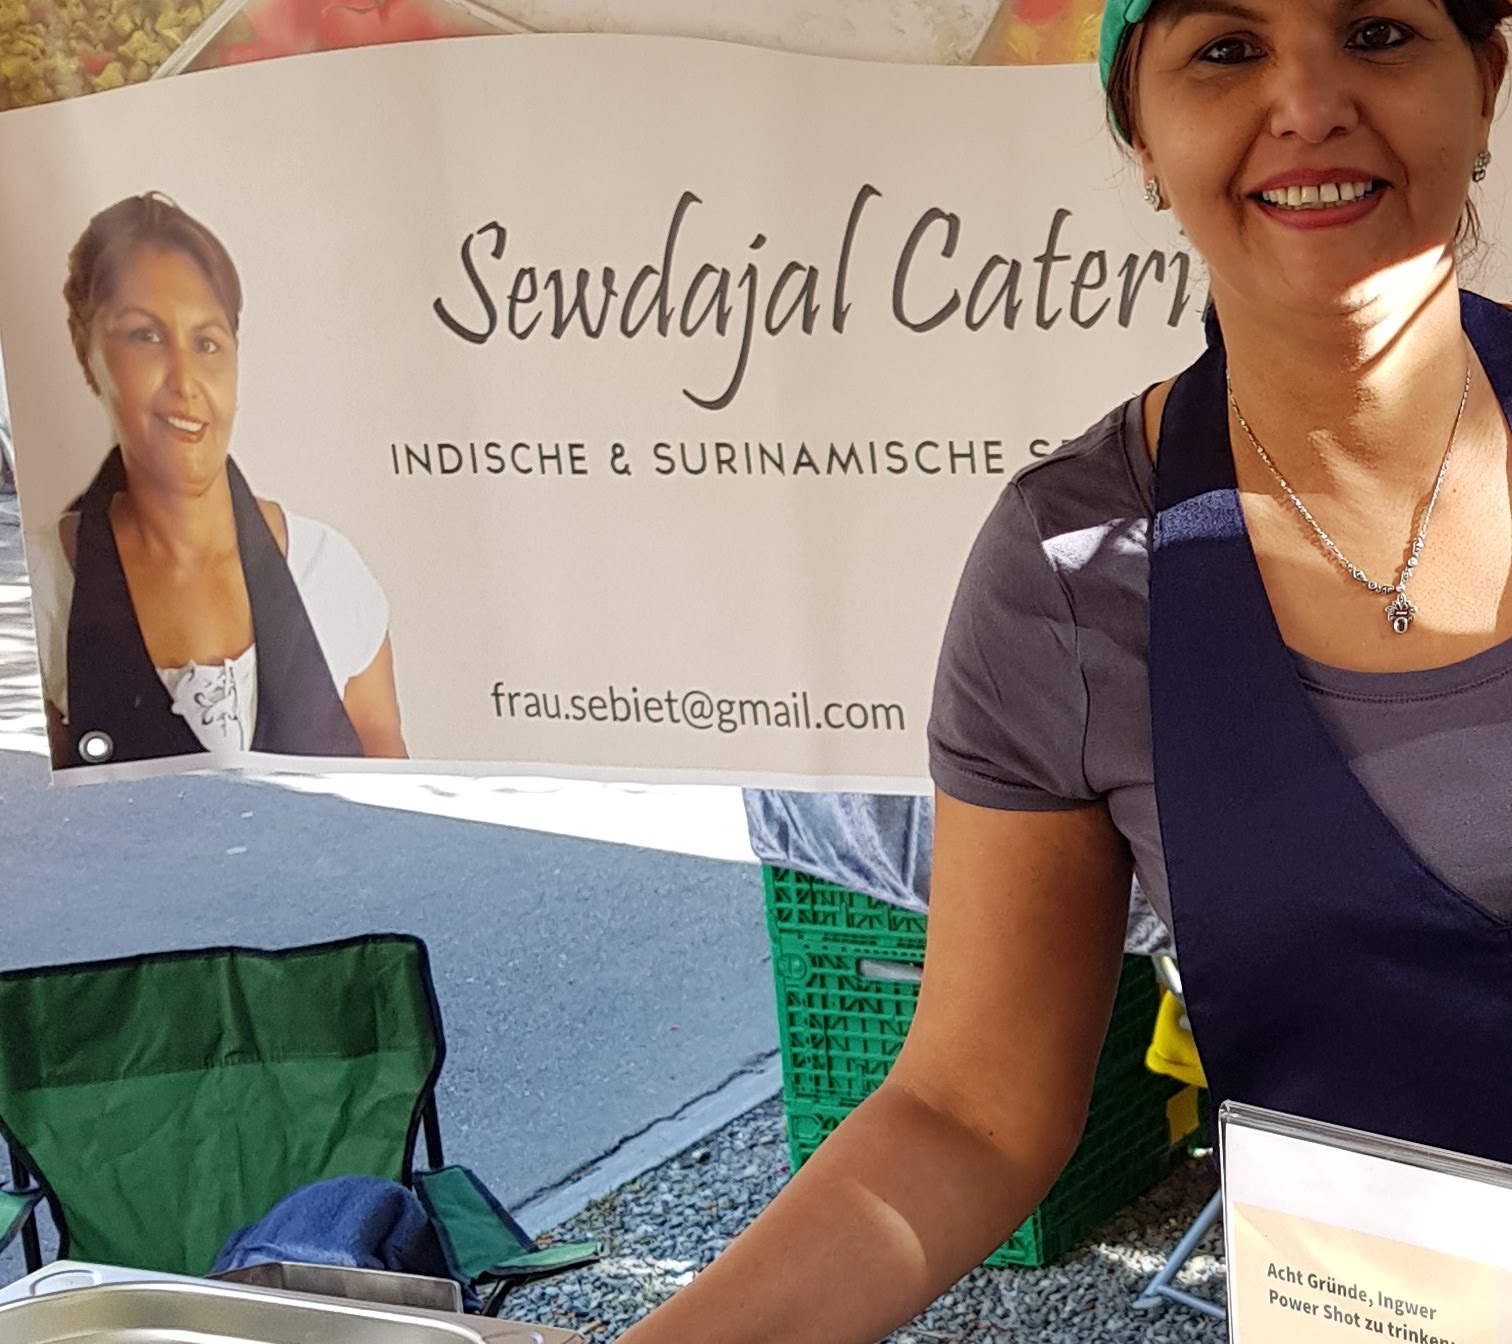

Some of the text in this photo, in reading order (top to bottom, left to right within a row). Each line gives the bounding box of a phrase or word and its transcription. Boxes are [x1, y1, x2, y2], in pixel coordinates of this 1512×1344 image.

[432, 183, 1194, 410] Sewdajal Cateri
[391, 442, 588, 475] INDISCHE
[610, 442, 632, 476] &
[653, 439, 1005, 476] SURINAMISCHE
[490, 681, 906, 735] frau.sebiet@gmail.com
[1267, 1263, 1437, 1319] Acht Gründe, Ingwer
[1269, 1289, 1318, 1316] Power
[1324, 1304, 1360, 1327] Shot
[1365, 1318, 1383, 1334] zu
